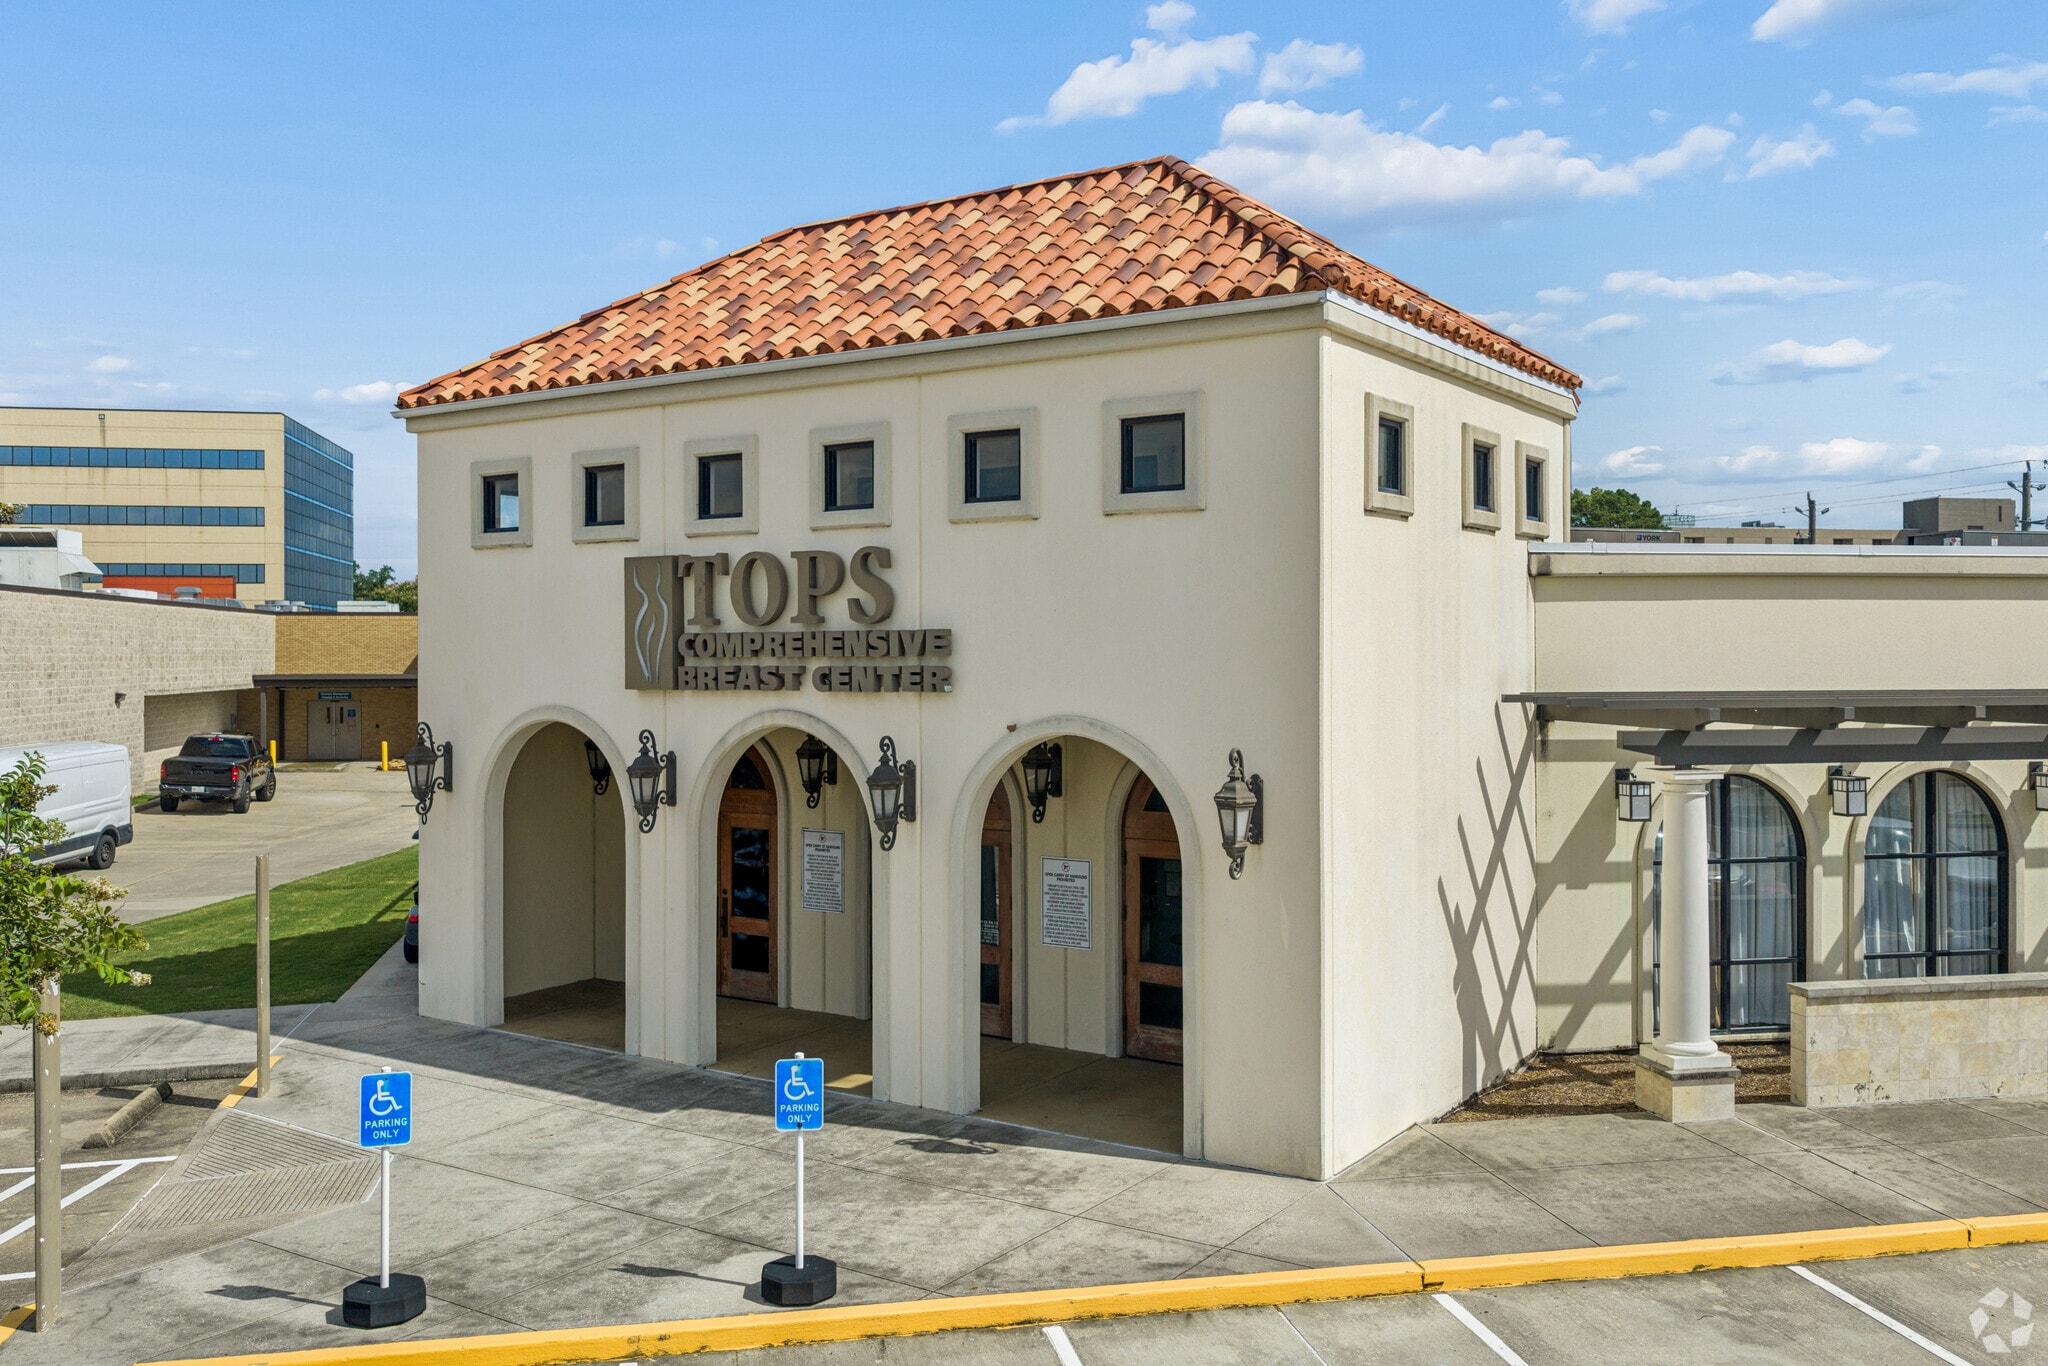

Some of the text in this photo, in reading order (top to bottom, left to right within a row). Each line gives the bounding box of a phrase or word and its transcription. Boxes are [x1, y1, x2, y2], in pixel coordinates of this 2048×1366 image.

[677, 545, 895, 626] TOPS
[677, 628, 953, 658] COMPREHENSIVE
[677, 665, 953, 692] BREAST CENTER
[780, 1103, 819, 1113] PARKING
[364, 1117, 408, 1129] PARKING
[787, 1114, 812, 1123] ONLY
[372, 1129, 399, 1139] ONLY
